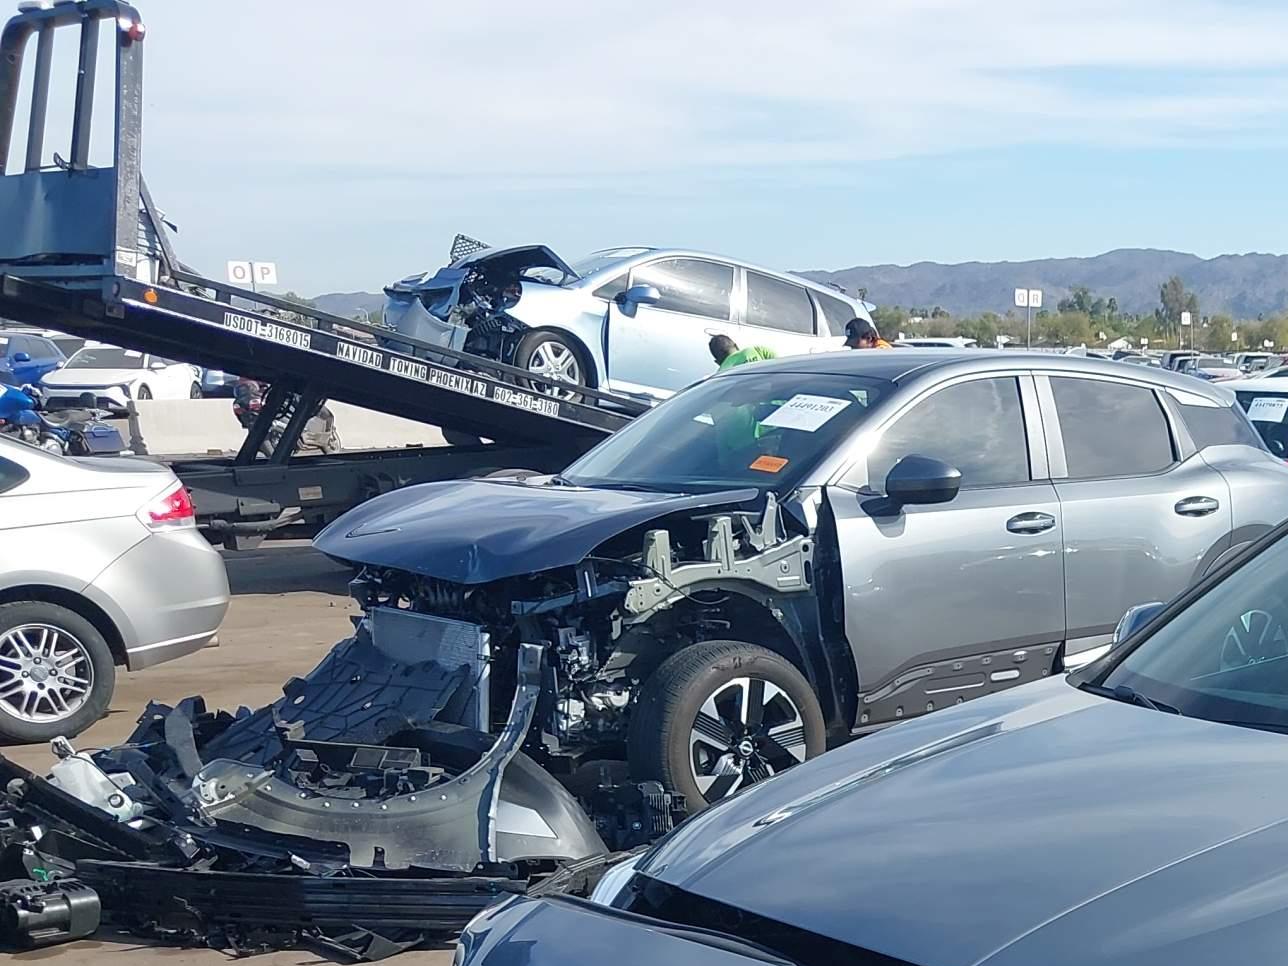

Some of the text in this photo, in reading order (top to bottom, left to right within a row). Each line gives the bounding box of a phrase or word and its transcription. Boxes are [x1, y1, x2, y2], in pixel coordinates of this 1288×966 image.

[260, 267, 271, 280] P
[338, 343, 382, 367] NAVIDAD
[391, 357, 427, 379] TOWING
[430, 369, 471, 392] PHOENIX
[473, 381, 487, 396] AZ
